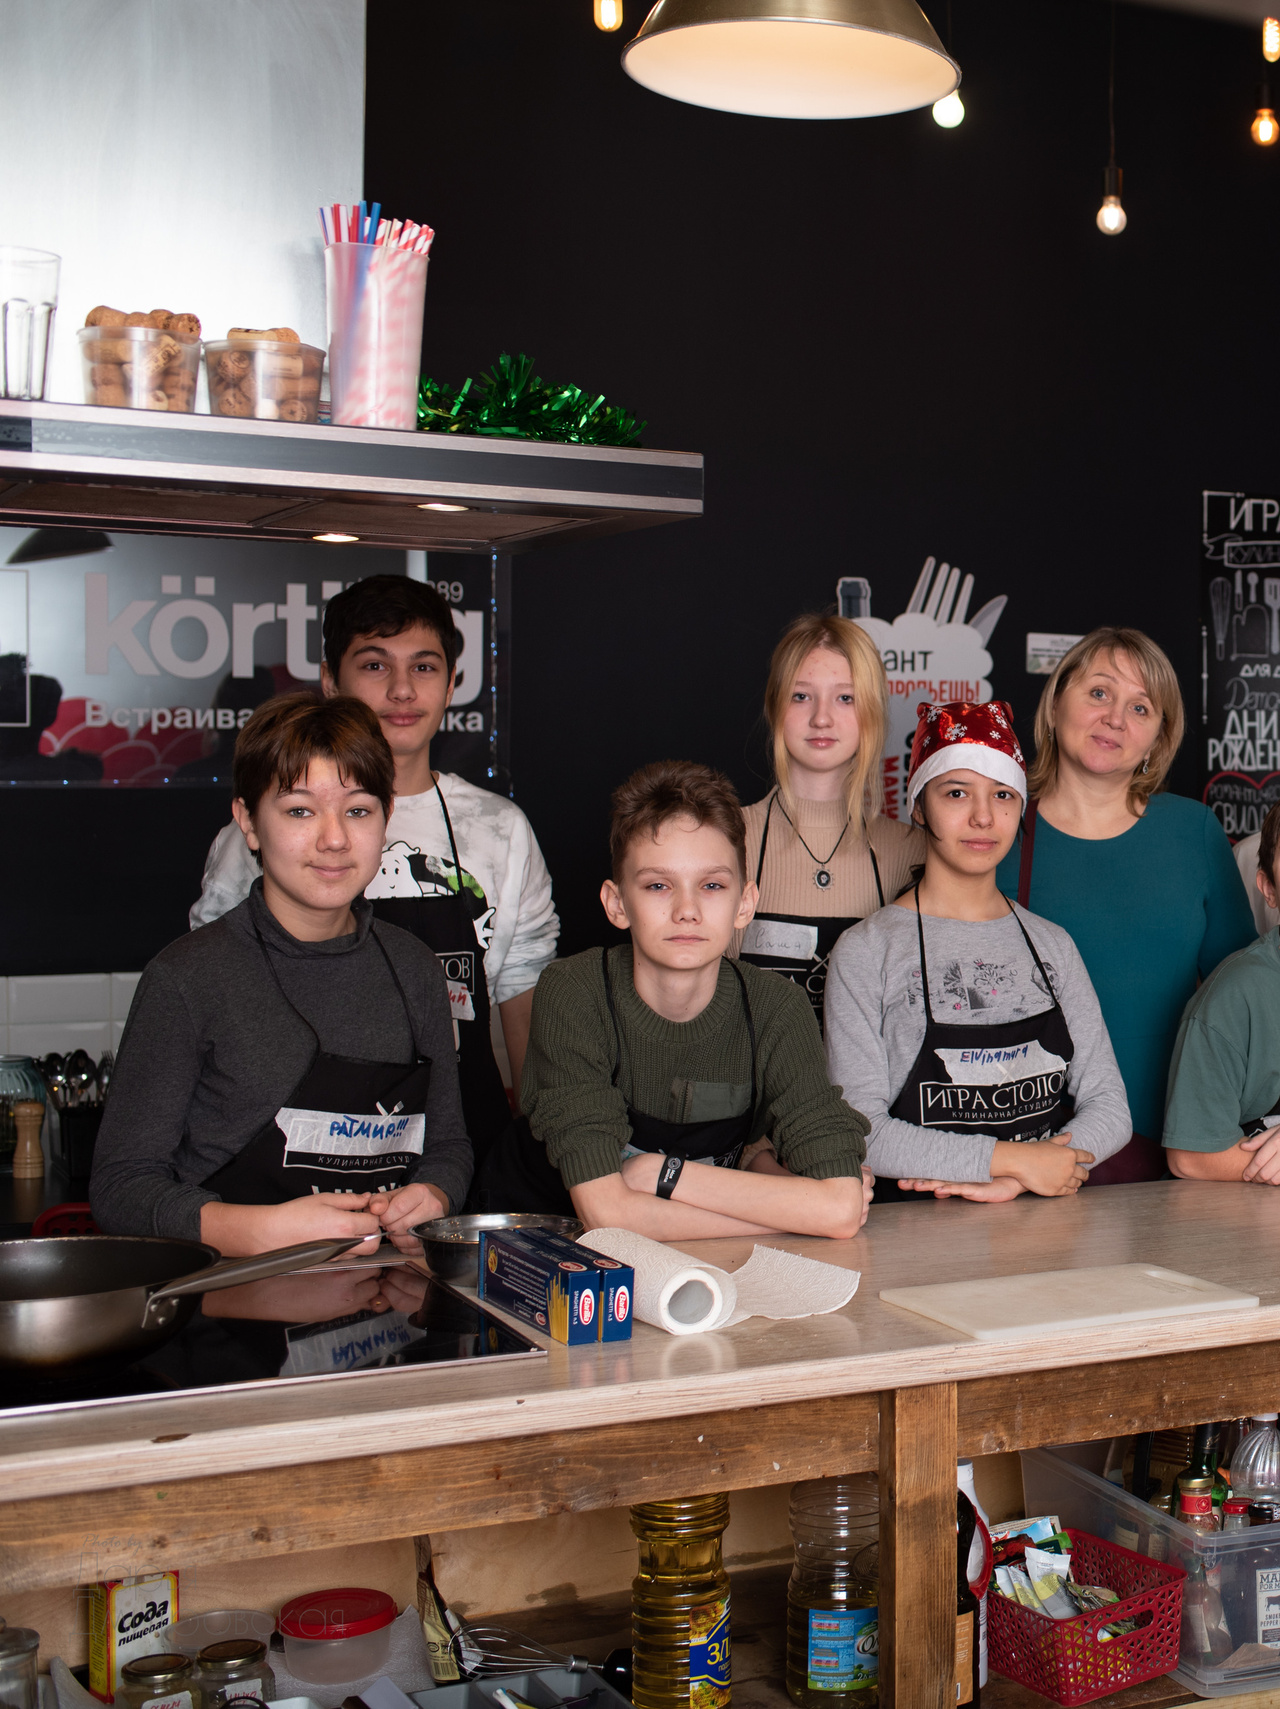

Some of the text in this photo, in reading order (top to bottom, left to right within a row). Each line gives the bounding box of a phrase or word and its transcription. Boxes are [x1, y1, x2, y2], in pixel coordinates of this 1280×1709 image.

[84, 572, 484, 706] körtg
[85, 702, 249, 735] Встраива
[1224, 710, 1278, 741] ДНИ
[926, 1088, 991, 1110] ИГРА
[952, 1108, 1016, 1119] КУЛИНАРНАЯ
[318, 1155, 383, 1167] КУЛИНАРНАЯ
[1259, 1582, 1274, 1590] FOR
[118, 1600, 169, 1633] Сода
[1260, 1619, 1279, 1627] PEPPER
[118, 1617, 169, 1647] пищевая
